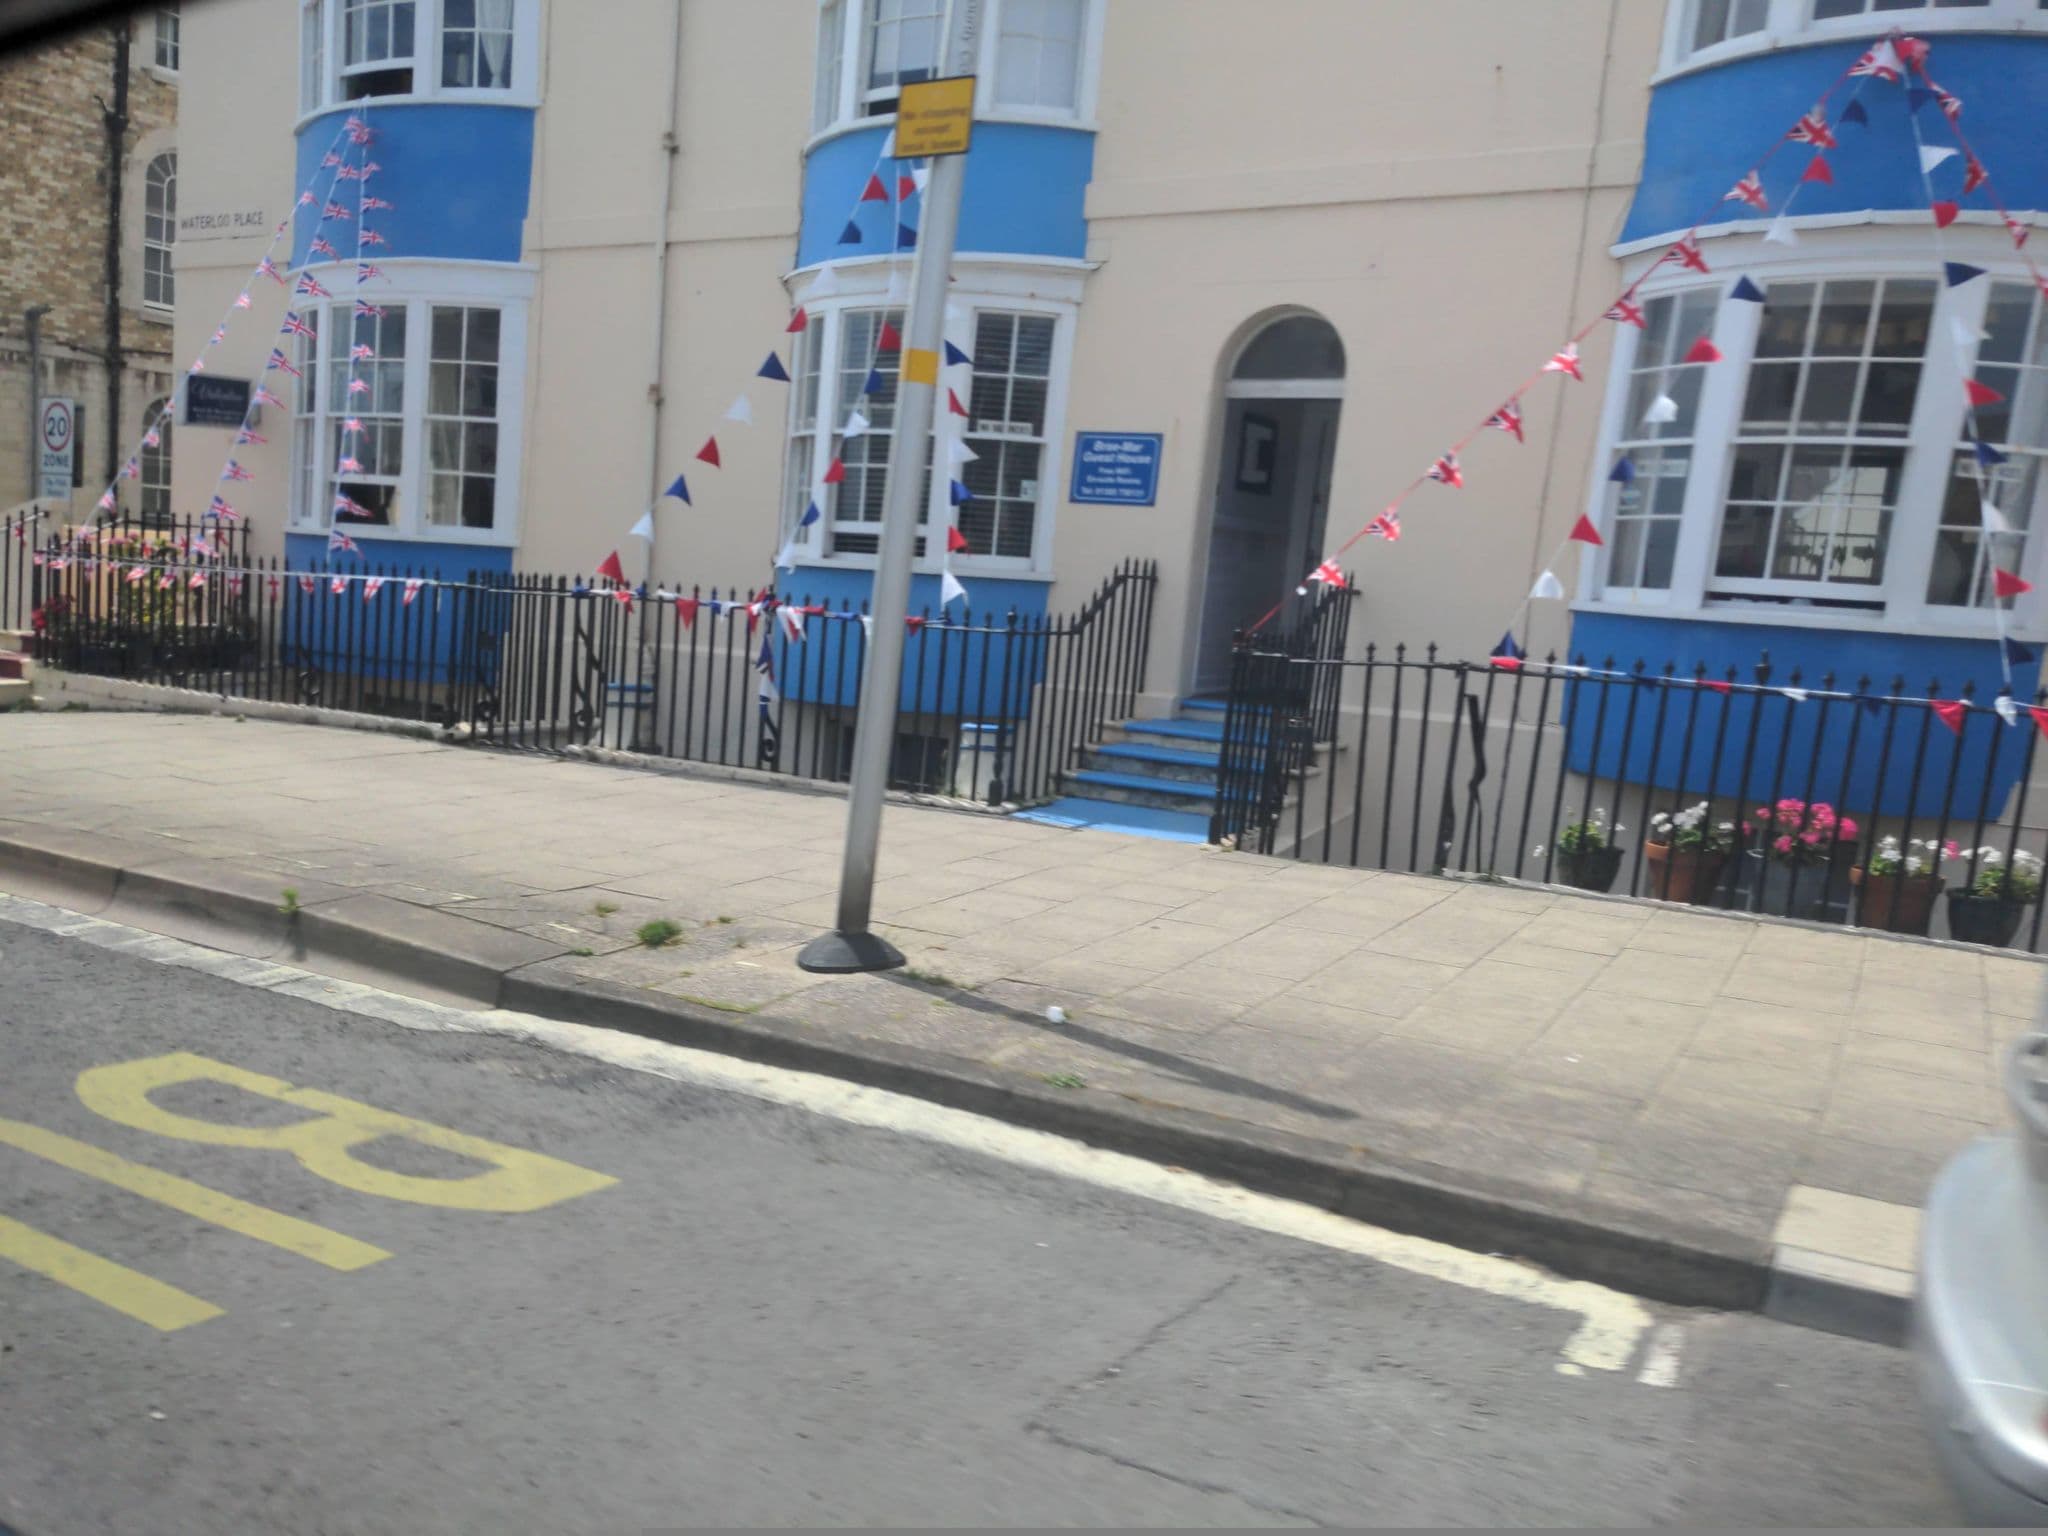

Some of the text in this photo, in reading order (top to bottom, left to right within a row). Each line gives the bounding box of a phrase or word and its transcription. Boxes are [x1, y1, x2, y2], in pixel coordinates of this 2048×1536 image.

[181, 210, 263, 230] WATERLOO PLACE
[47, 416, 66, 437] 20
[43, 454, 69, 467] ZONE
[1082, 451, 1152, 465] Guest House
[0, 1051, 622, 1332] BU
